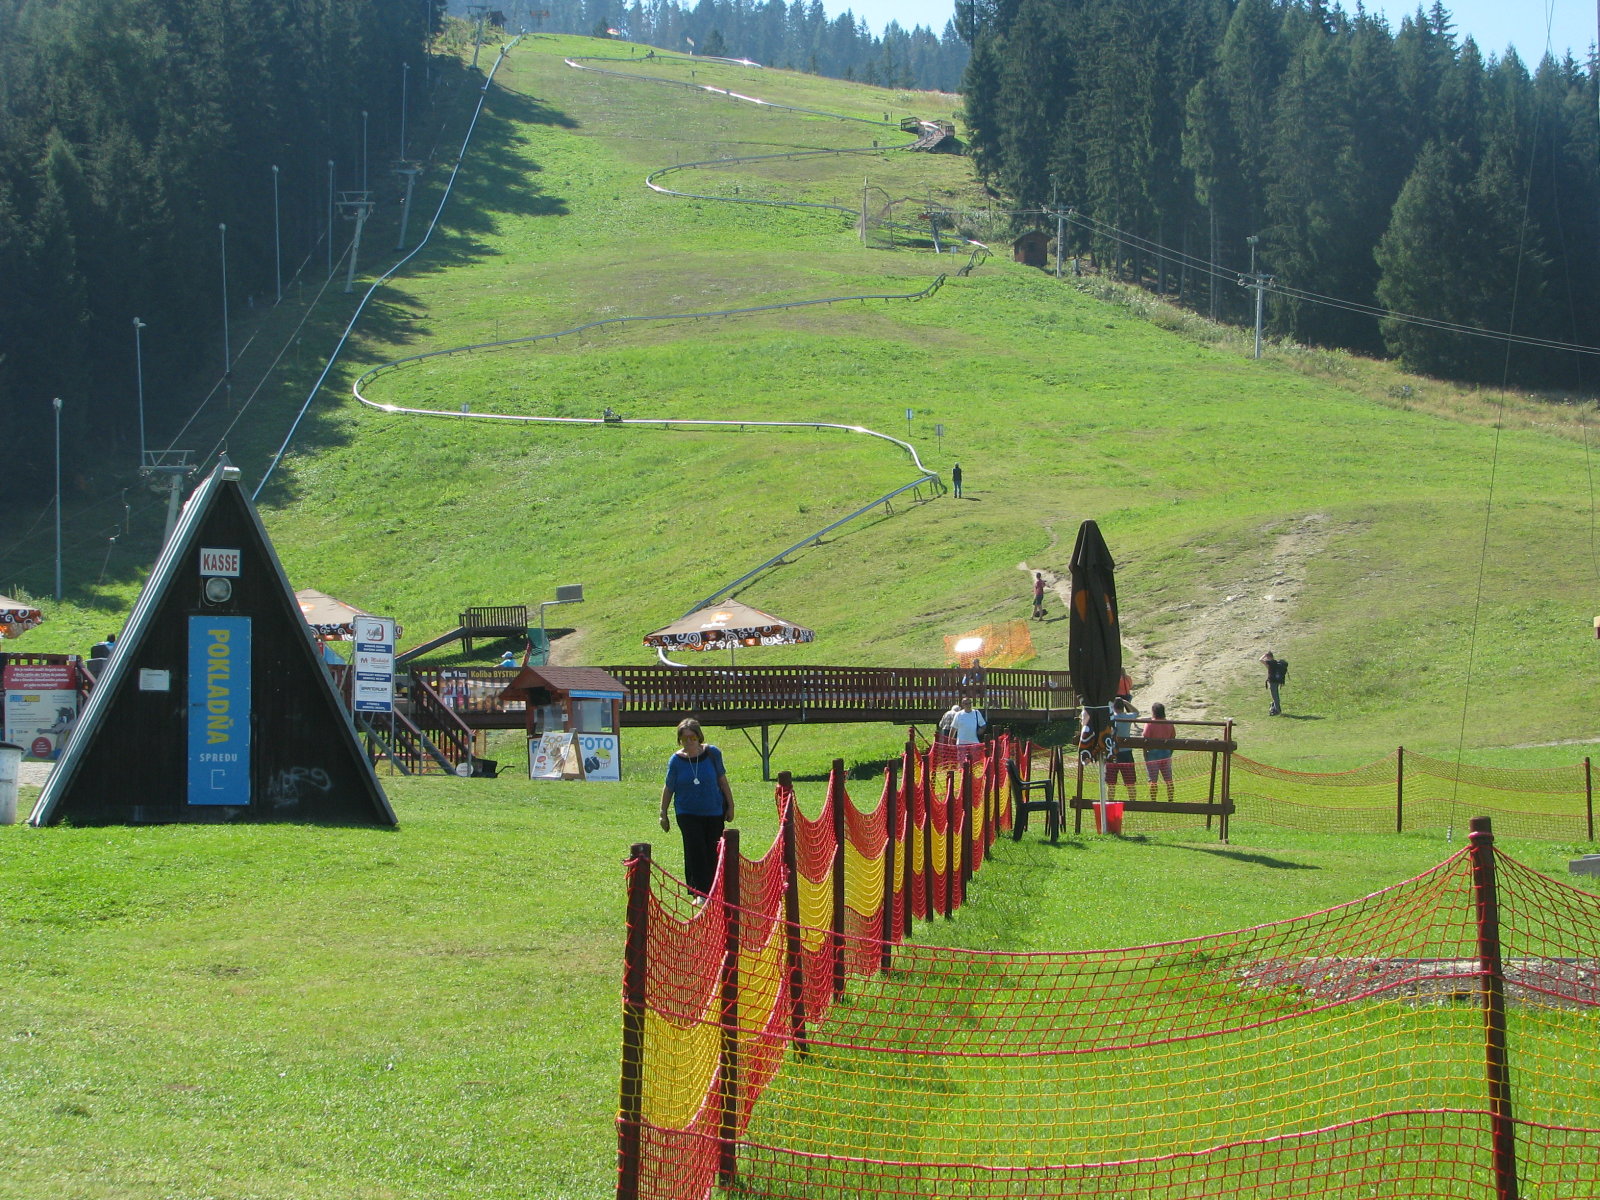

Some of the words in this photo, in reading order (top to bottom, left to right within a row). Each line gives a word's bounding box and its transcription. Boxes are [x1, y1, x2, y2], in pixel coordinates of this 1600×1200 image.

[203, 553, 238, 572] KASSE
[458, 670, 467, 678] km
[471, 670, 492, 678] Koliba
[206, 629, 234, 744] POKLADŇA
[543, 735, 563, 743] ZOO
[199, 753, 238, 762] SPREDU
